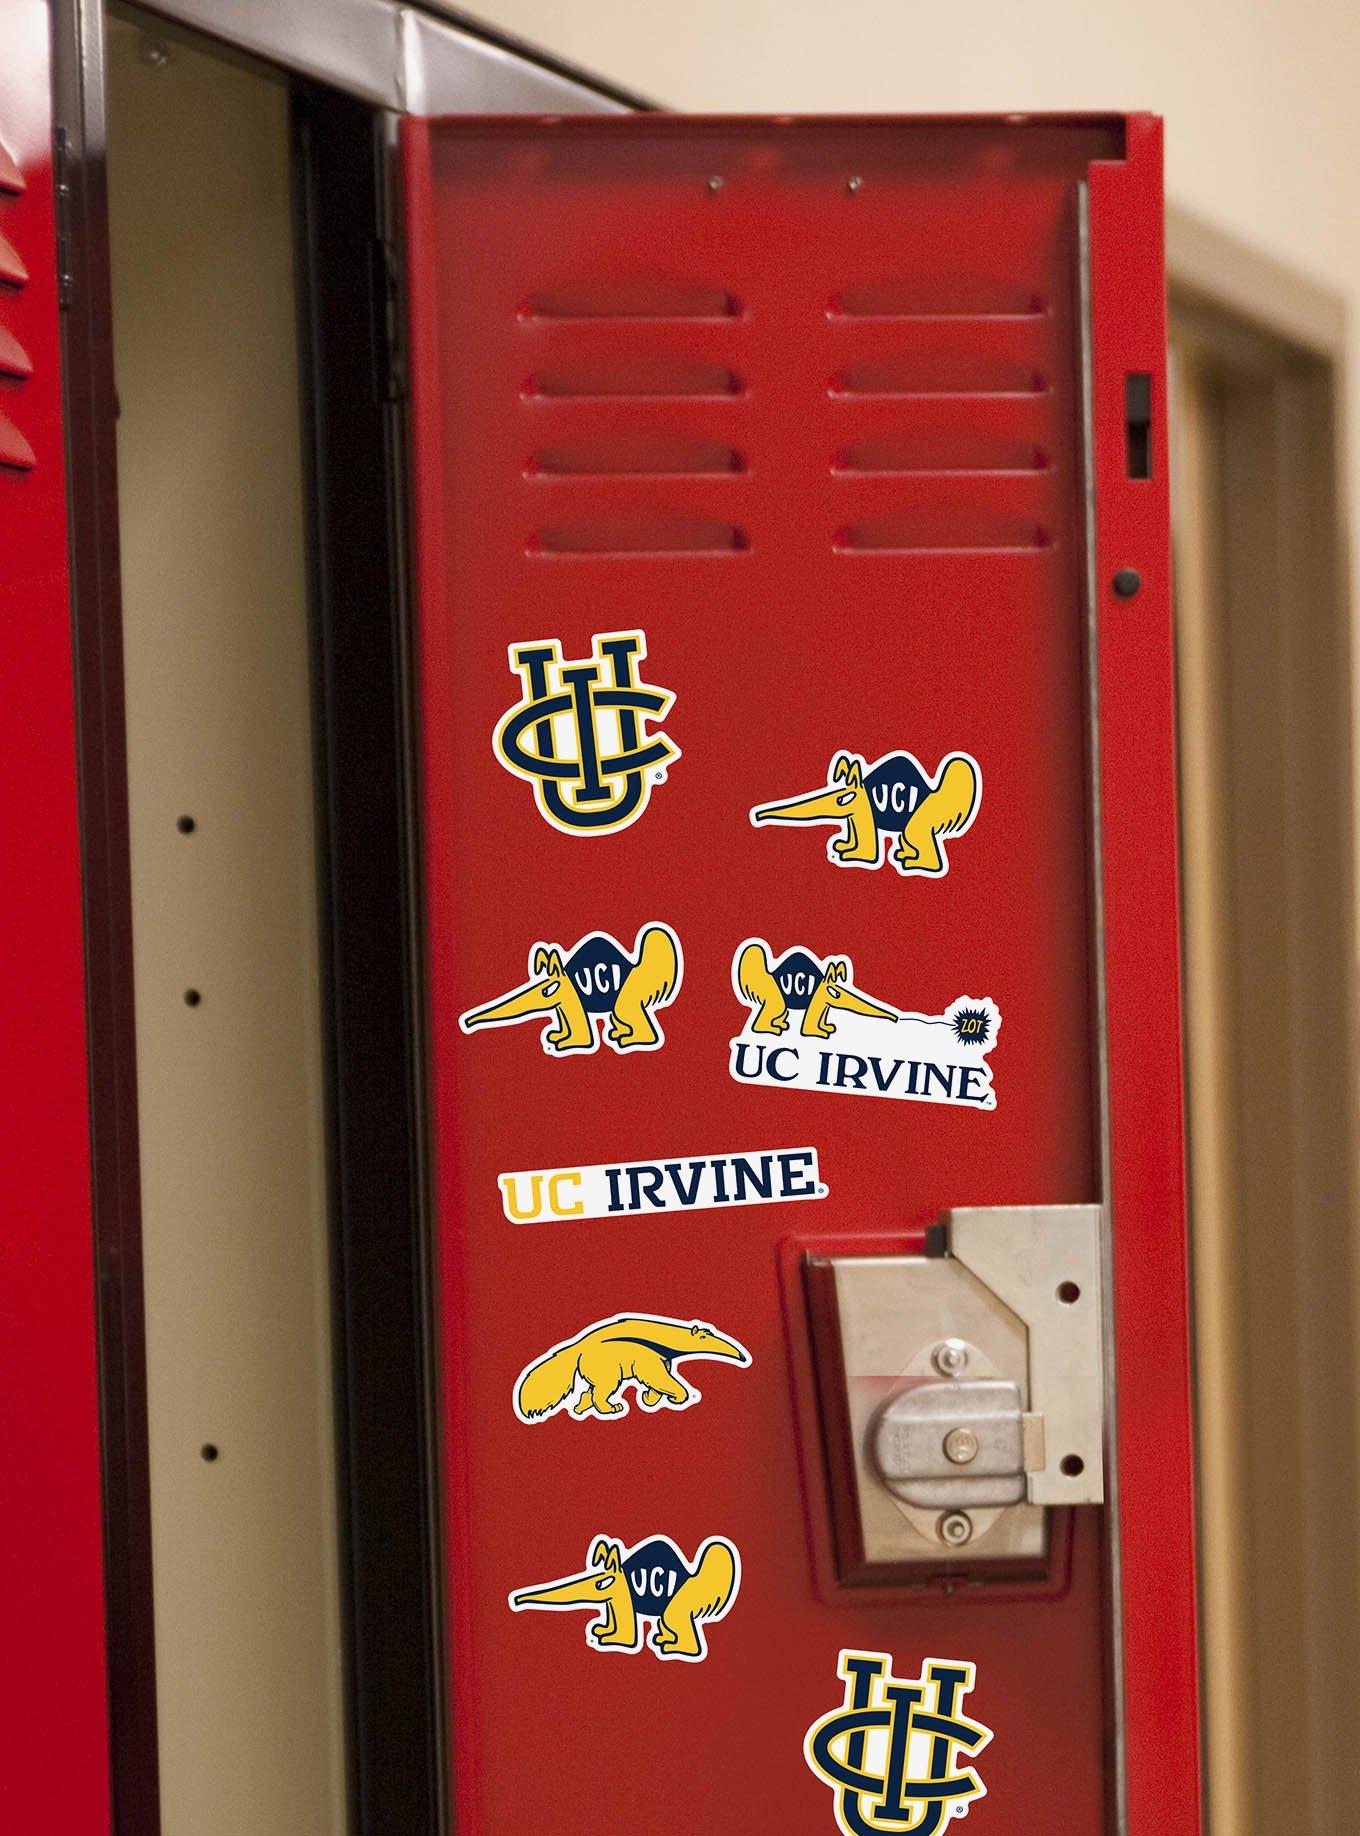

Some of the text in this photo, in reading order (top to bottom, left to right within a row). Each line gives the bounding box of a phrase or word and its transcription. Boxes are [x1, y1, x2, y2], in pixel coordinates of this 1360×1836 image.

[872, 782, 918, 812] UCI
[574, 963, 620, 995] UCI
[779, 972, 815, 996] UCI
[961, 1018, 983, 1034] ZOT
[735, 1043, 989, 1103] UC IRVINE
[503, 1152, 815, 1219] UC IRVINE
[631, 1566, 677, 1597] UCI
